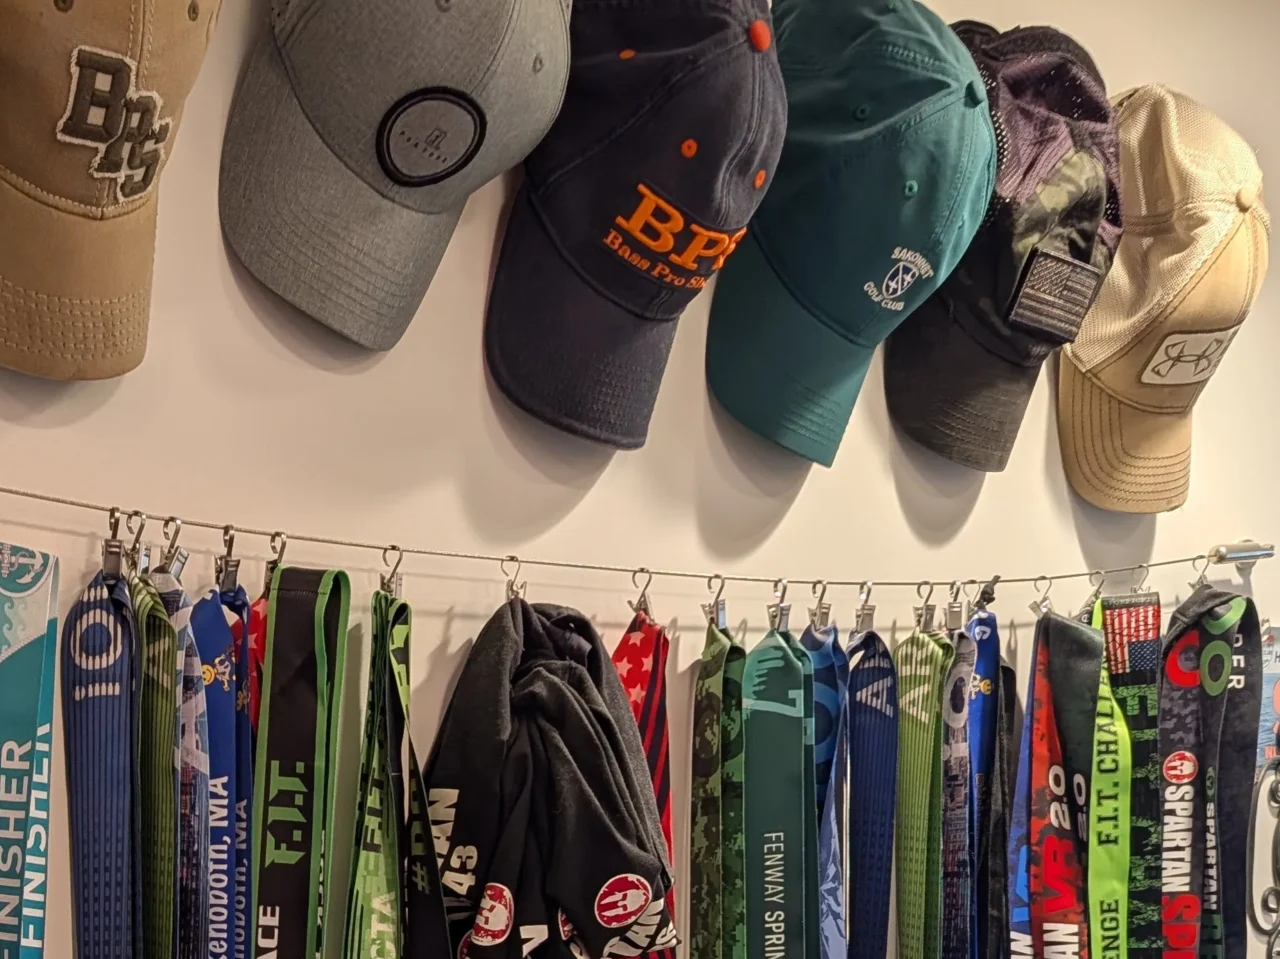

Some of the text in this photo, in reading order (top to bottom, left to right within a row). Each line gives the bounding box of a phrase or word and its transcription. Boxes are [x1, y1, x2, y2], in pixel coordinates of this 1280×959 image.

[603, 228, 686, 287] Bass Pro
[209, 774, 230, 828] MA
[264, 760, 309, 869] F.I.T.
[1097, 780, 1121, 848] F.I.T.
[762, 831, 784, 903] FENWAY
[1162, 785, 1195, 893] SPARTAN
[1203, 801, 1218, 912] SPARTAN
